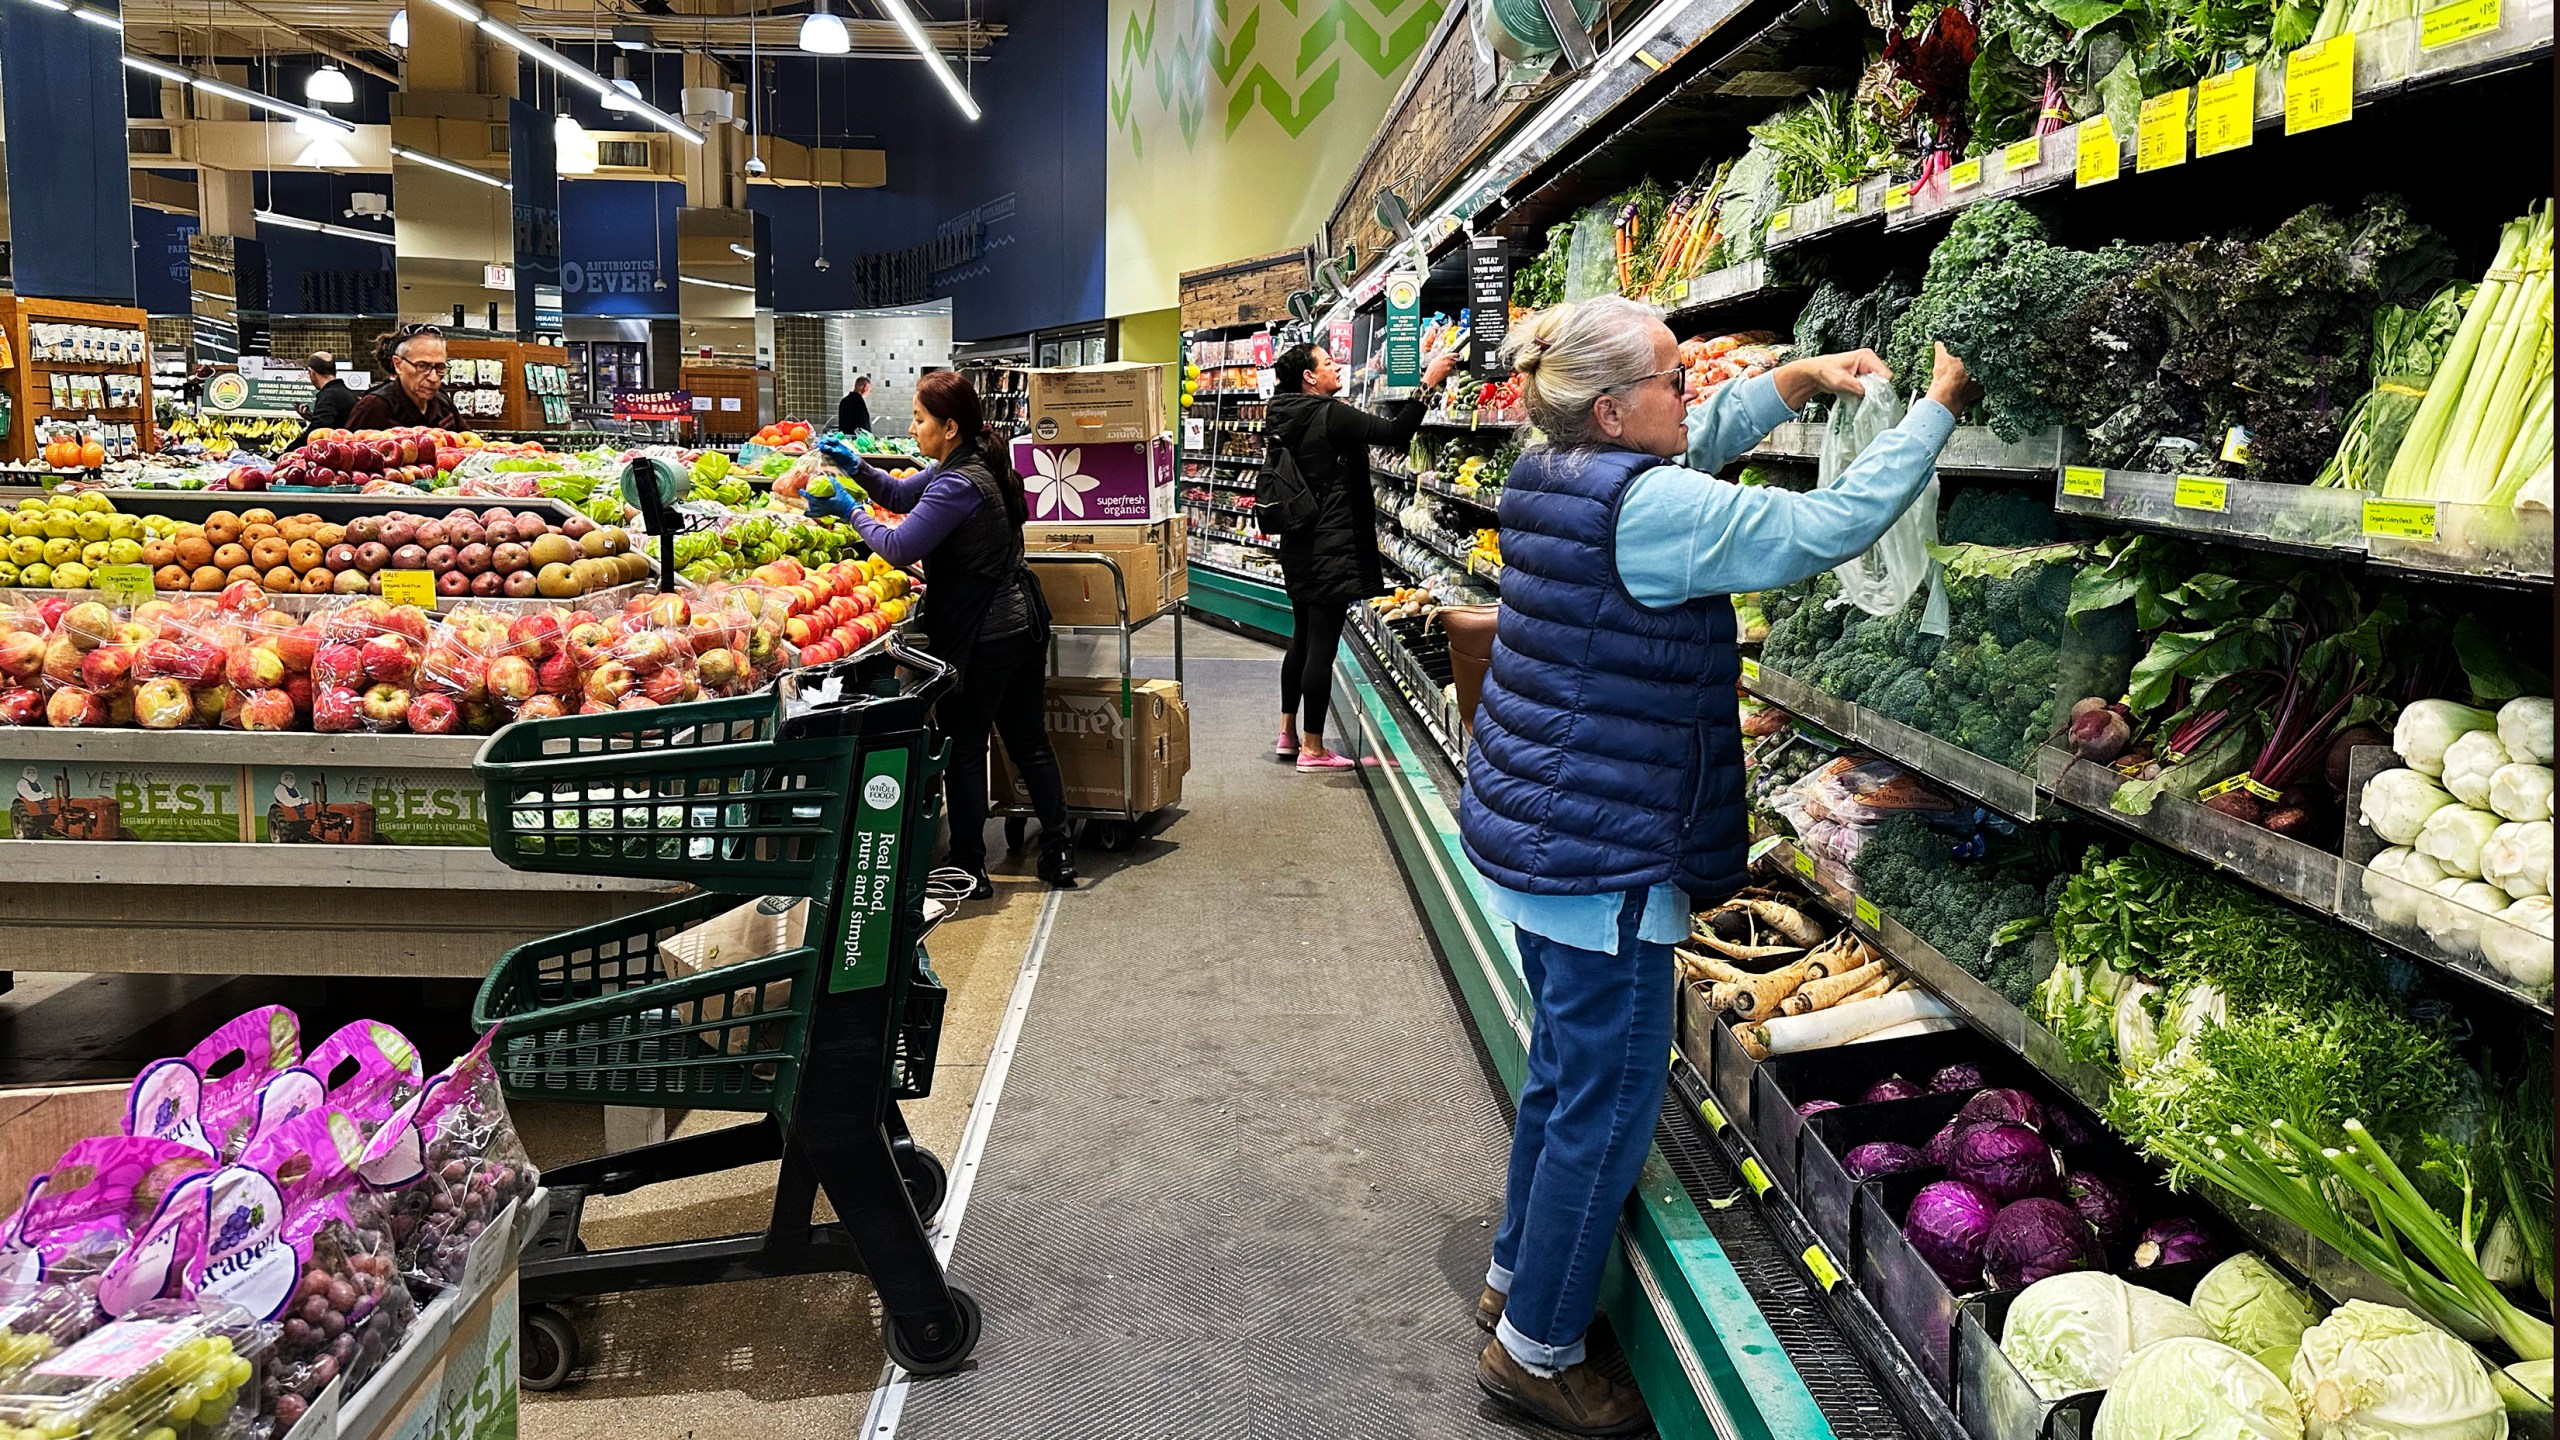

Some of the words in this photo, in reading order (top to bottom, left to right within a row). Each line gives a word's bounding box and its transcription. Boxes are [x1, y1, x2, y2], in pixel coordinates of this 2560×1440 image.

[1478, 256, 1499, 265] TREAT
[1473, 266, 1488, 274] YOUR
[1489, 265, 1504, 273] BODY
[1332, 328, 1351, 336] LOCAL
[626, 392, 671, 403] CHEERS
[638, 403, 649, 411] TO
[651, 403, 680, 414] FALL
[1097, 495, 1146, 507] superfresh
[1104, 504, 1146, 517] organics
[2369, 515, 2386, 524] Organic
[2386, 517, 2400, 525] Celery
[86, 771, 153, 790] YETI'S
[342, 776, 410, 795] YETI'S
[869, 783, 896, 793] WHOLE
[115, 783, 231, 815] BEST
[869, 792, 896, 800] FOODS
[1885, 793, 1908, 805] Valley
[1910, 795, 1948, 806] Harmony
[371, 788, 484, 820] BEST
[122, 817, 156, 826] LEGENDARY
[157, 818, 178, 826] FRUITS
[186, 818, 221, 827] VEGETABLES
[378, 822, 411, 831] LEGENDARY
[413, 823, 433, 831] FRUITS
[441, 824, 476, 832] VEGETABLES
[857, 830, 873, 871] pure
[876, 832, 896, 870] Real
[853, 875, 868, 907] and
[867, 874, 890, 917] food,
[844, 911, 866, 971] simple.
